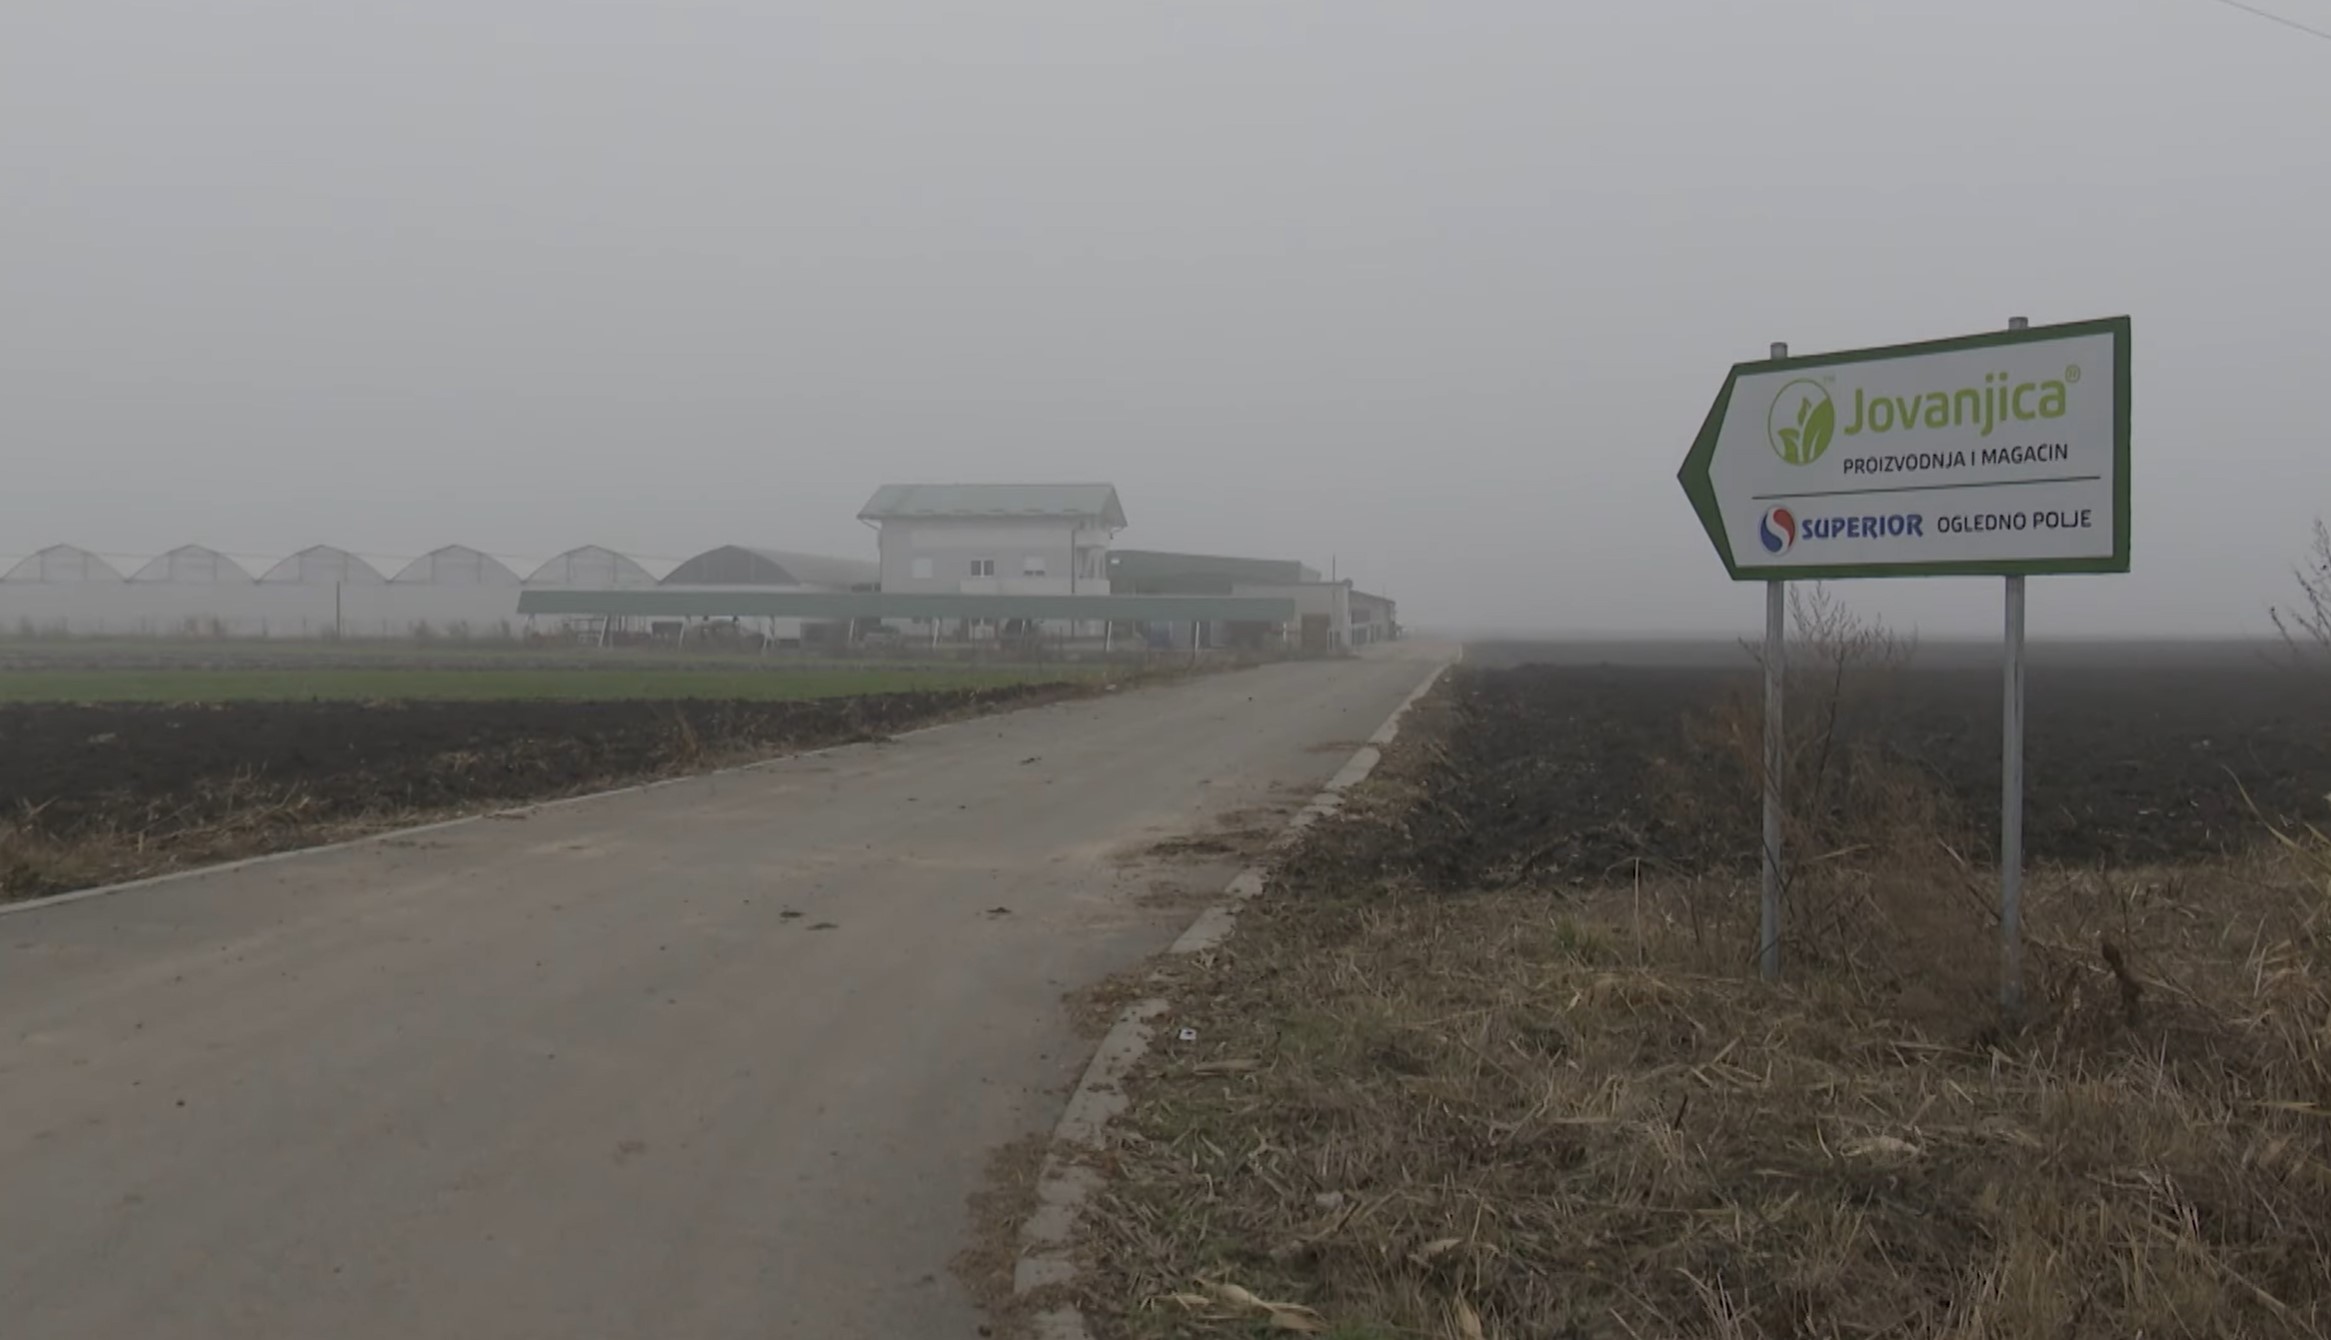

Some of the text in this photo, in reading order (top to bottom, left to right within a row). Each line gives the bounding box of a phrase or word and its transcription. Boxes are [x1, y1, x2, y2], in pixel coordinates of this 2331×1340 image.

[1843, 371, 2067, 437] Jovanjica
[1843, 443, 2069, 475] PROIZVODNJA I MAGACIN
[1801, 509, 2092, 540] SUPERIOR OGLEDNO POLJE
